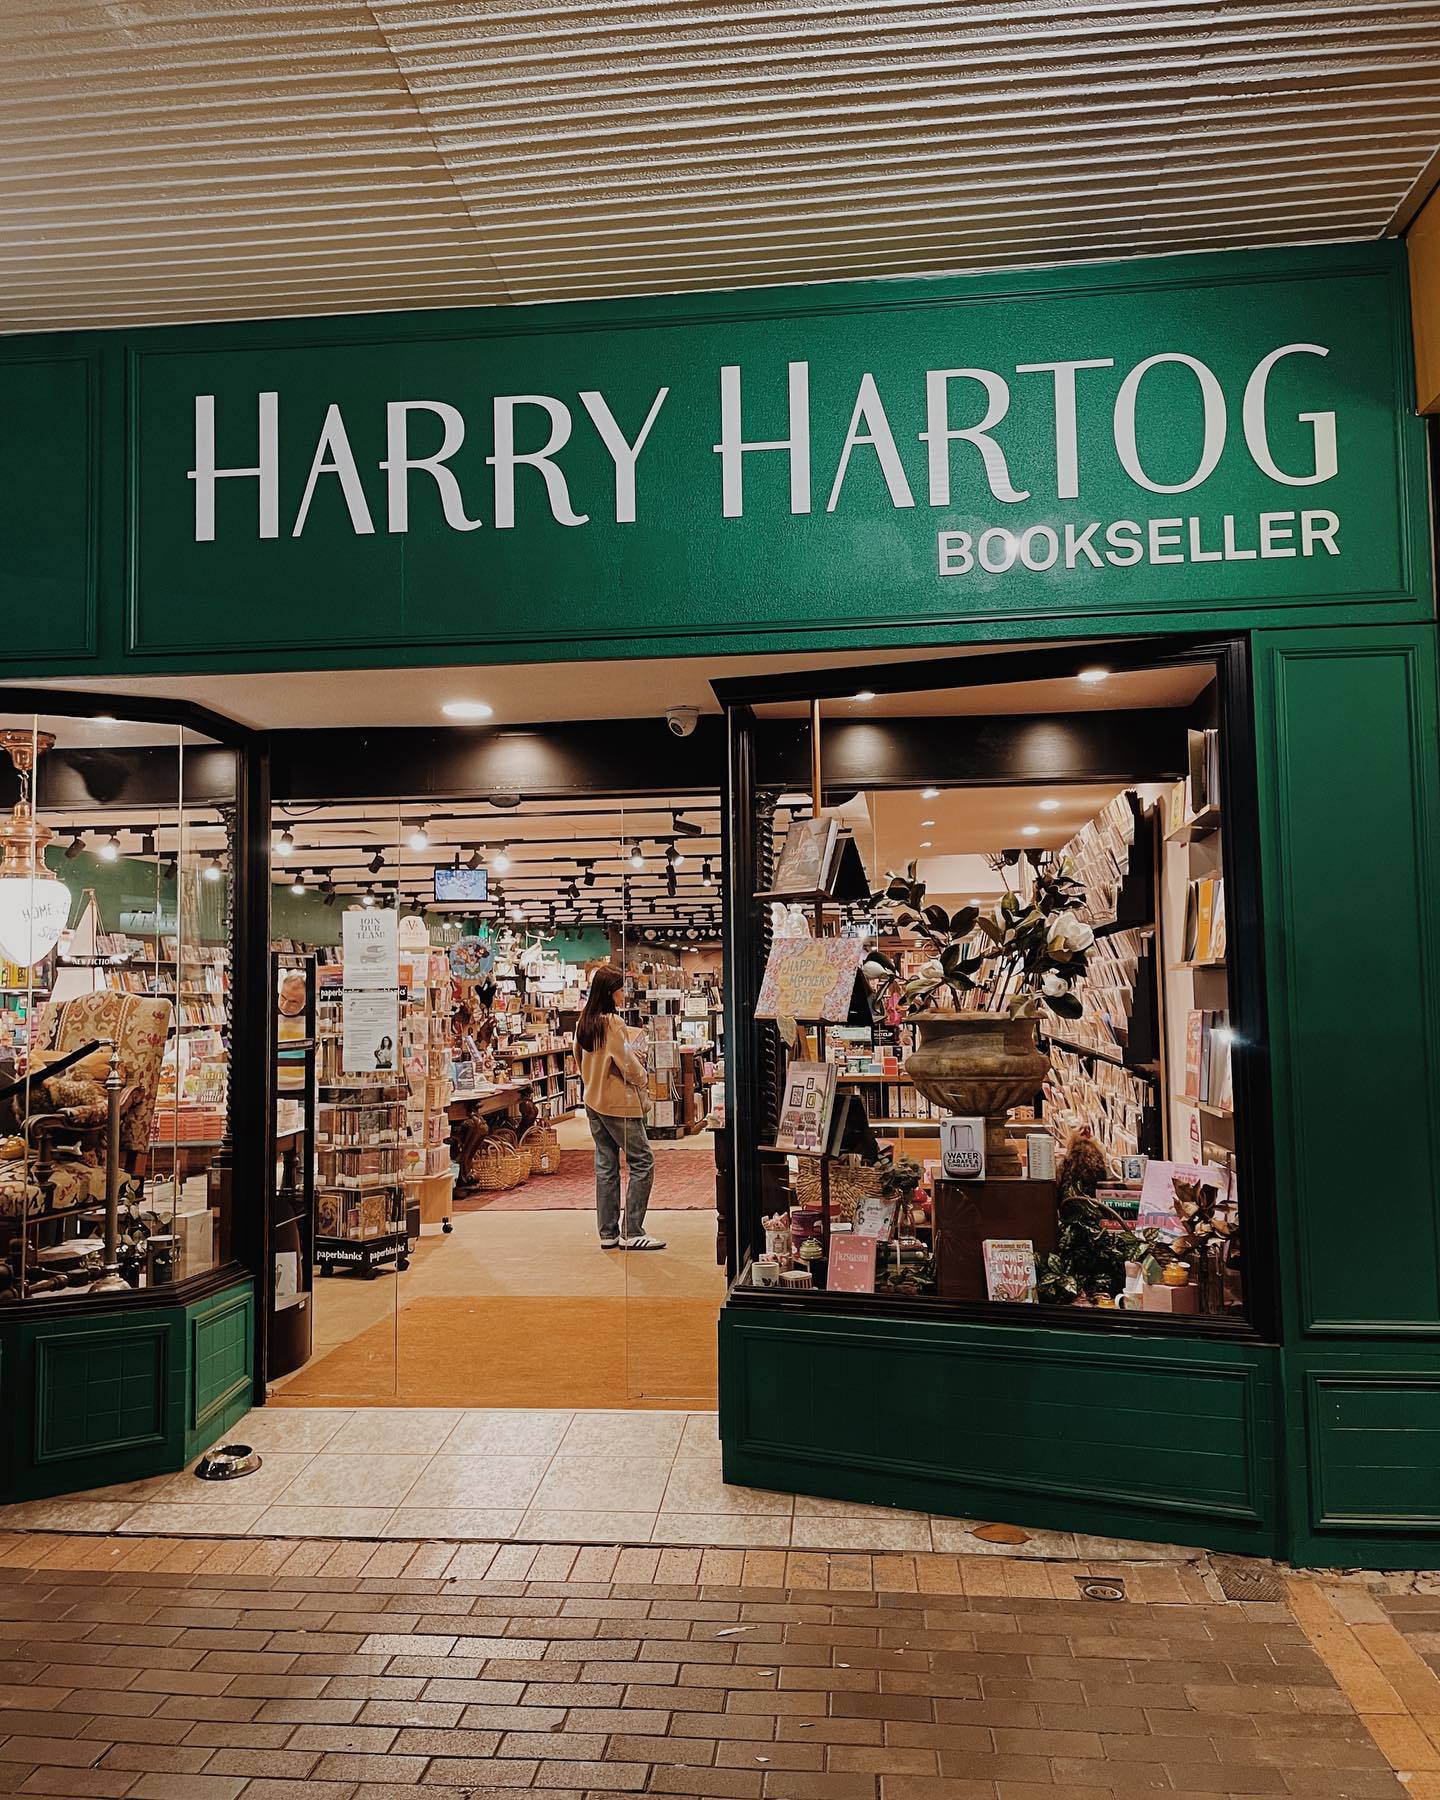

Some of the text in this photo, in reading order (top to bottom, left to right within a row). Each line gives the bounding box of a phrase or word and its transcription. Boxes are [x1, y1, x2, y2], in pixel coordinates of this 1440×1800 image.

[186, 343, 1339, 543] HARRY HARTOG
[937, 509, 1342, 577] BOOKSELLER
[782, 959, 817, 974] HAPPY
[791, 990, 815, 1004] DAY
[947, 1152, 979, 1160] WATER
[316, 1249, 363, 1261] paperblanks
[995, 1264, 1032, 1275] LIVING
